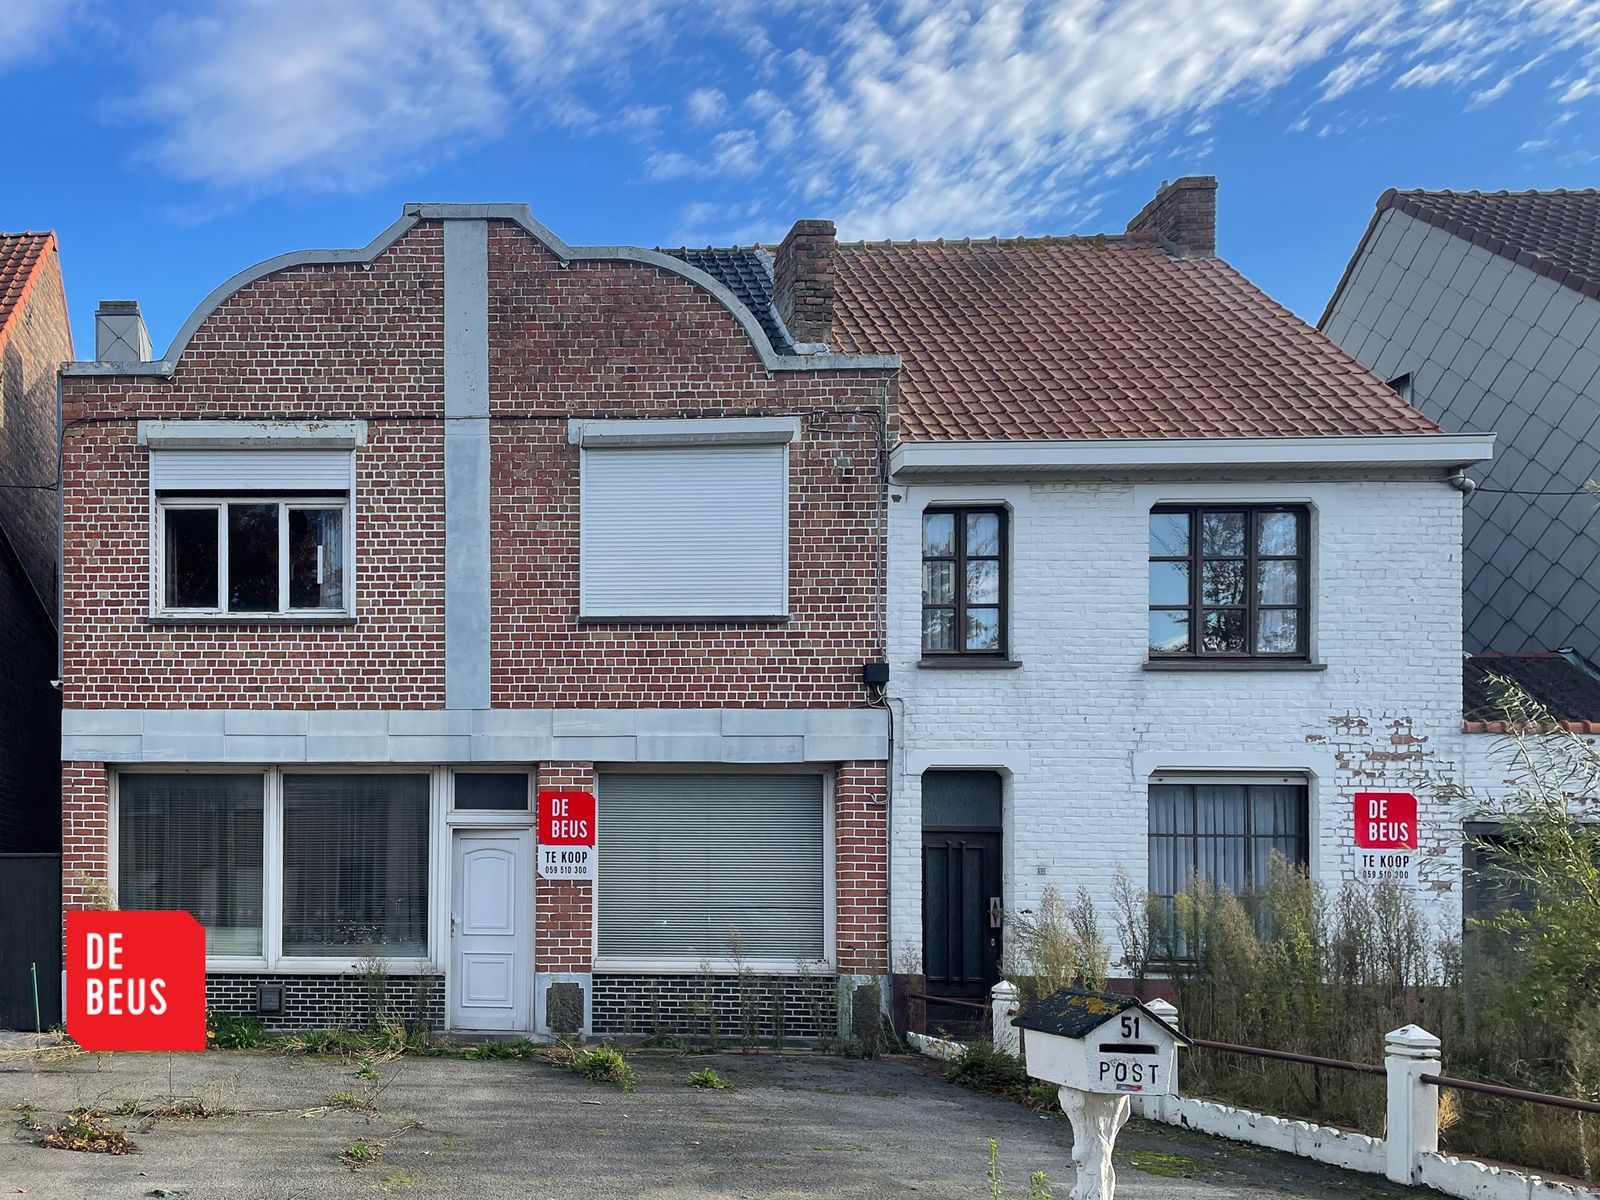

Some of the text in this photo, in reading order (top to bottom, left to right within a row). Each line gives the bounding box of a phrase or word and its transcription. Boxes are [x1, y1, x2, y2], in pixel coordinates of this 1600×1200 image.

[552, 799, 568, 816] DE
[1369, 800, 1387, 818] DE
[552, 820, 587, 838] BEUS
[1369, 822, 1409, 841] BEUS
[545, 852, 587, 863] TE KOOP
[1363, 855, 1409, 867] TE KOOP
[545, 866, 587, 874] 059 510 300
[1121, 1016, 1140, 1039] 51
[1100, 1061, 1159, 1084] POST
